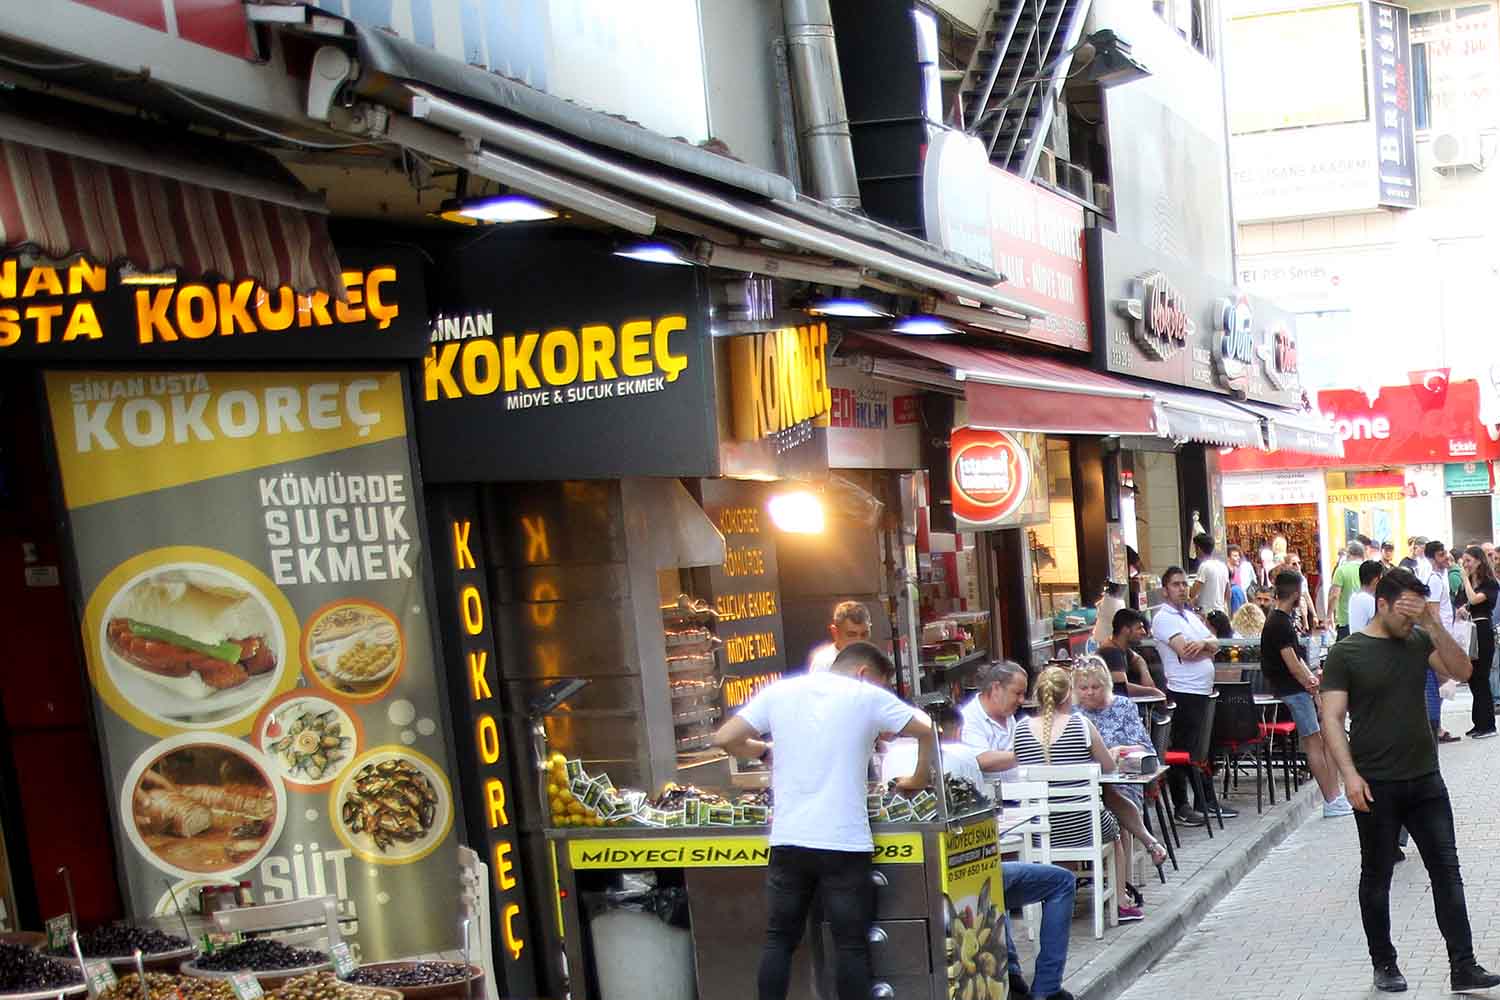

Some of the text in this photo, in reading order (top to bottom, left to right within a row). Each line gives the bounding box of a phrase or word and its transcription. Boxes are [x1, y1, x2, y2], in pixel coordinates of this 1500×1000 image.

[0, 301, 103, 347] STA
[135, 267, 399, 345] KOKOREÇ
[424, 315, 689, 402] KOKOREÇ
[69, 373, 209, 402] SİNAN USTA
[506, 375, 666, 411] MİDYE & SUCUK EKMEK
[72, 377, 381, 454] KOKOREÇ
[259, 472, 407, 507] KÖMÜRDE
[265, 505, 411, 546] SUCUK
[271, 542, 415, 585] EKMEK
[727, 632, 777, 665] MİDYE TAVA
[453, 520, 525, 962] KOKOREÇ
[582, 845, 685, 864] MİDYECİ
[690, 844, 768, 864] SİNAN
